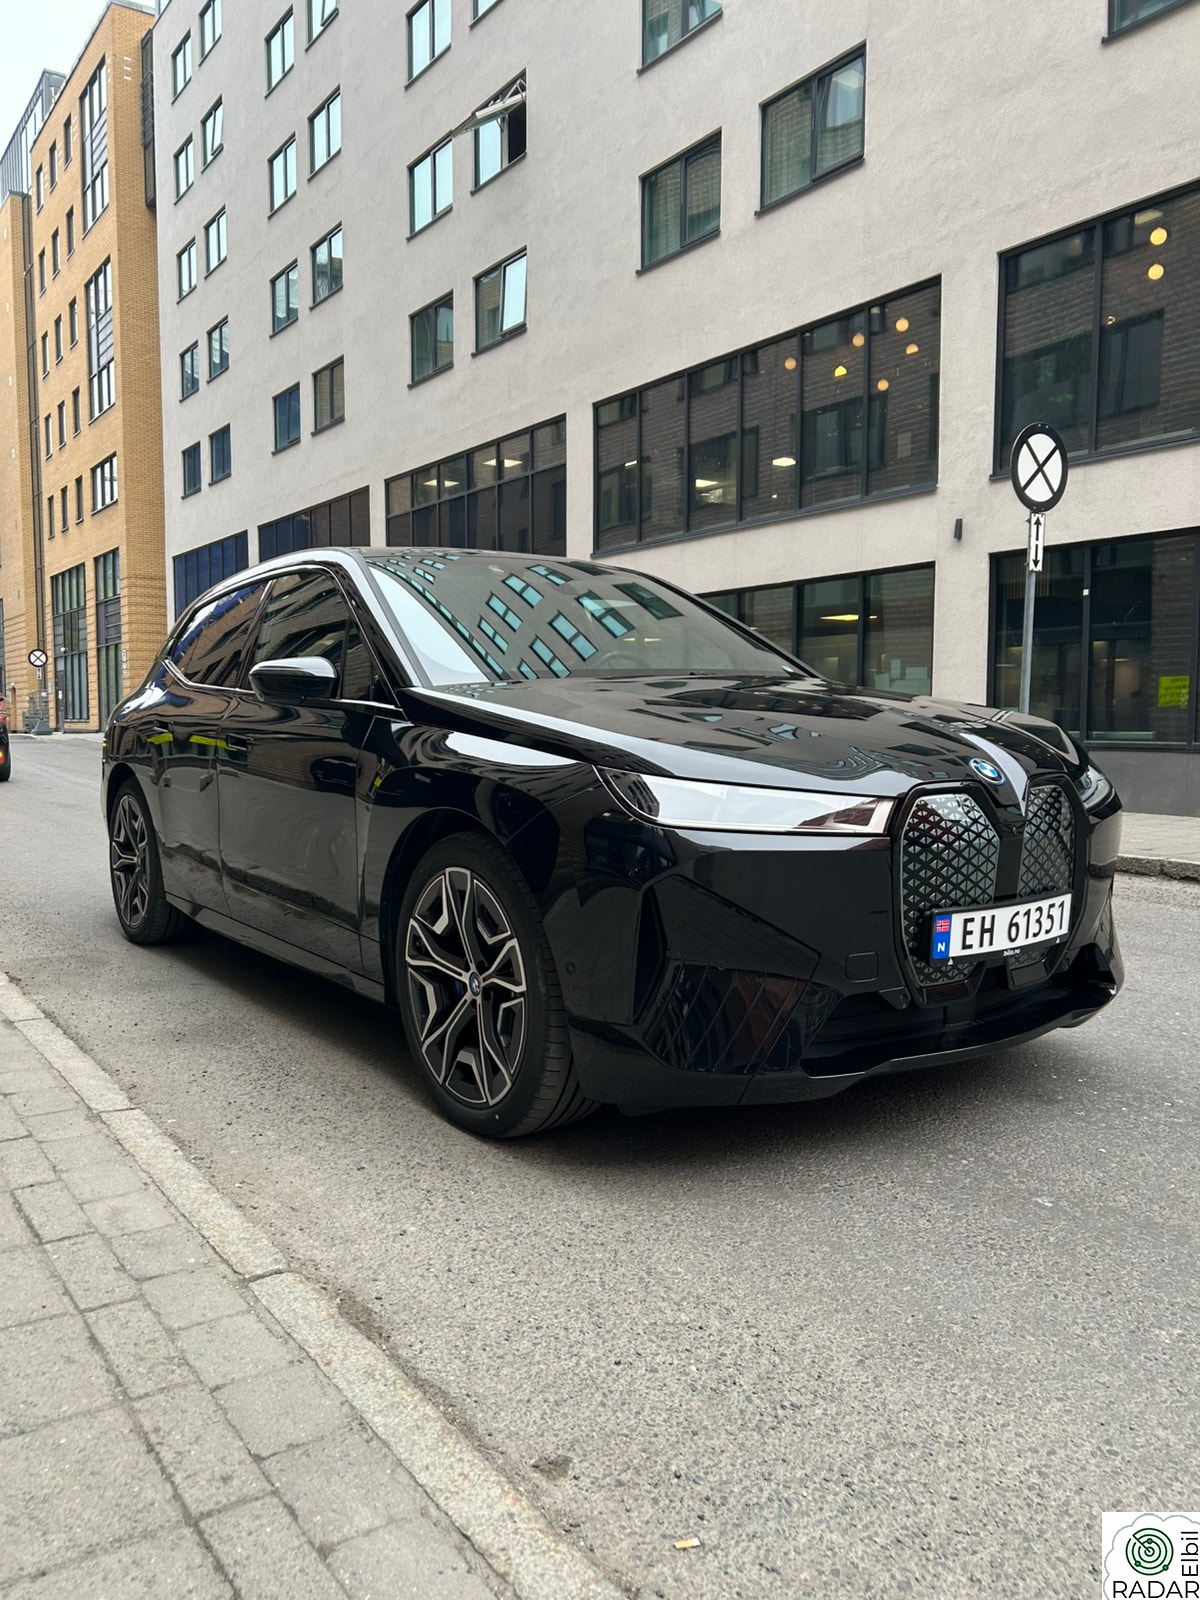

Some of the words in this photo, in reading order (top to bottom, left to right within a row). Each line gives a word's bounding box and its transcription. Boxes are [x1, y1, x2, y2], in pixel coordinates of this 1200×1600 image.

[961, 914, 996, 951] EH
[1007, 900, 1066, 943] 61351
[937, 942, 946, 952] N
